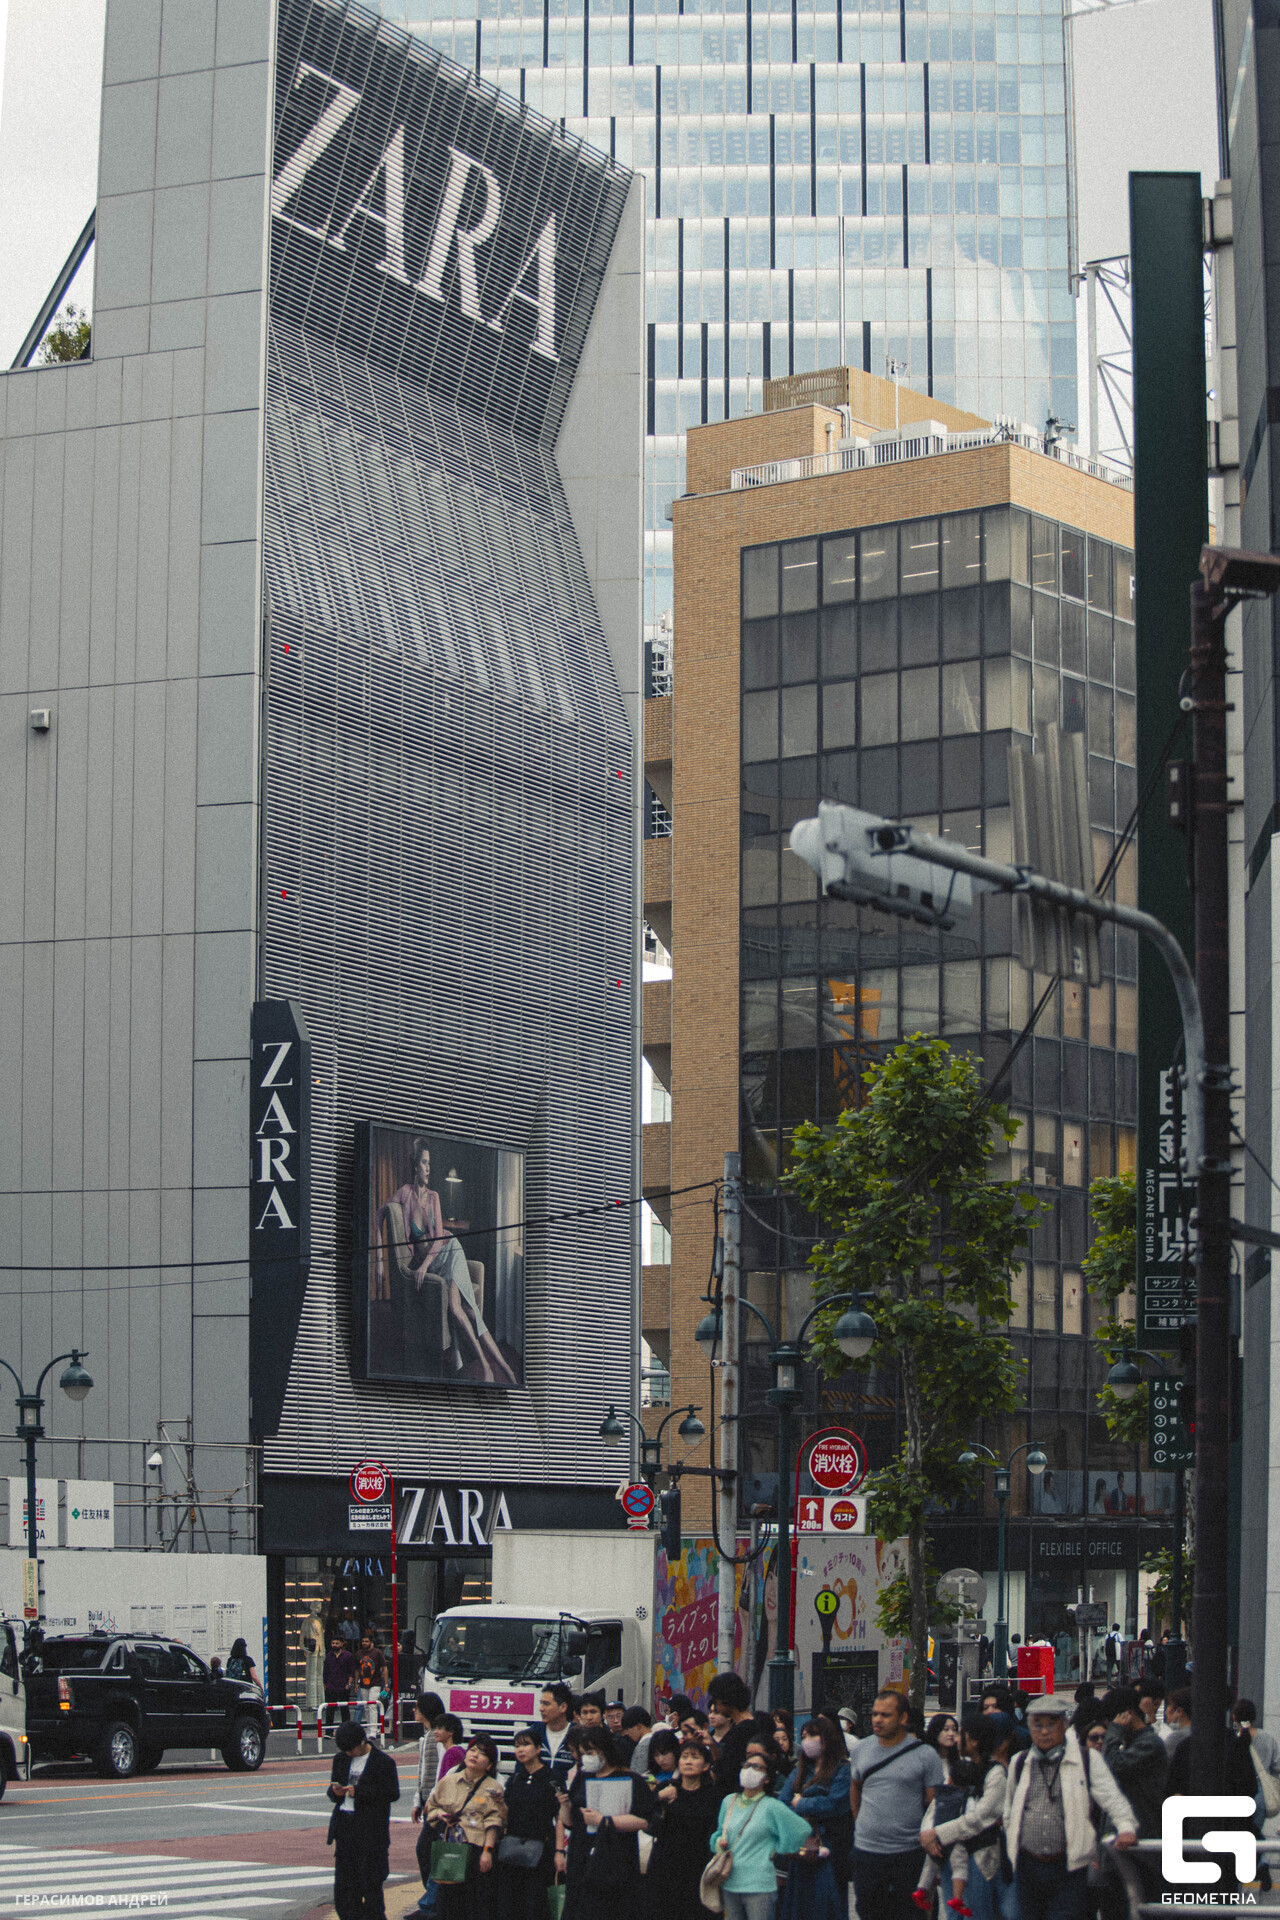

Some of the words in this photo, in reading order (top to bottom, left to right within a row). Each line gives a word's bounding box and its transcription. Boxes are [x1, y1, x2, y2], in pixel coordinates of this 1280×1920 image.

[271, 61, 560, 363] ZARA
[255, 1042, 297, 1230] ZARA
[1145, 1168, 1155, 1218] MEGANE
[1145, 1222, 1155, 1263] ICHIBA
[1152, 1279, 1197, 1289] サングス
[1154, 1381, 1184, 1391] FLO
[814, 1453, 854, 1474] 消火栓
[358, 1476, 383, 1490] 消火栓
[81, 1508, 110, 1521] 住友林業
[400, 1486, 513, 1545] ZARA
[833, 1512, 855, 1522] ガスト
[801, 1520, 822, 1530] 200m
[23, 1529, 46, 1540] TDA
[1040, 1542, 1082, 1556] FLEXIBLE
[1088, 1542, 1123, 1555] OFFICE
[88, 1610, 102, 1621] Build
[668, 1601, 718, 1641] ライブって
[470, 1695, 514, 1710] ミクチャ
